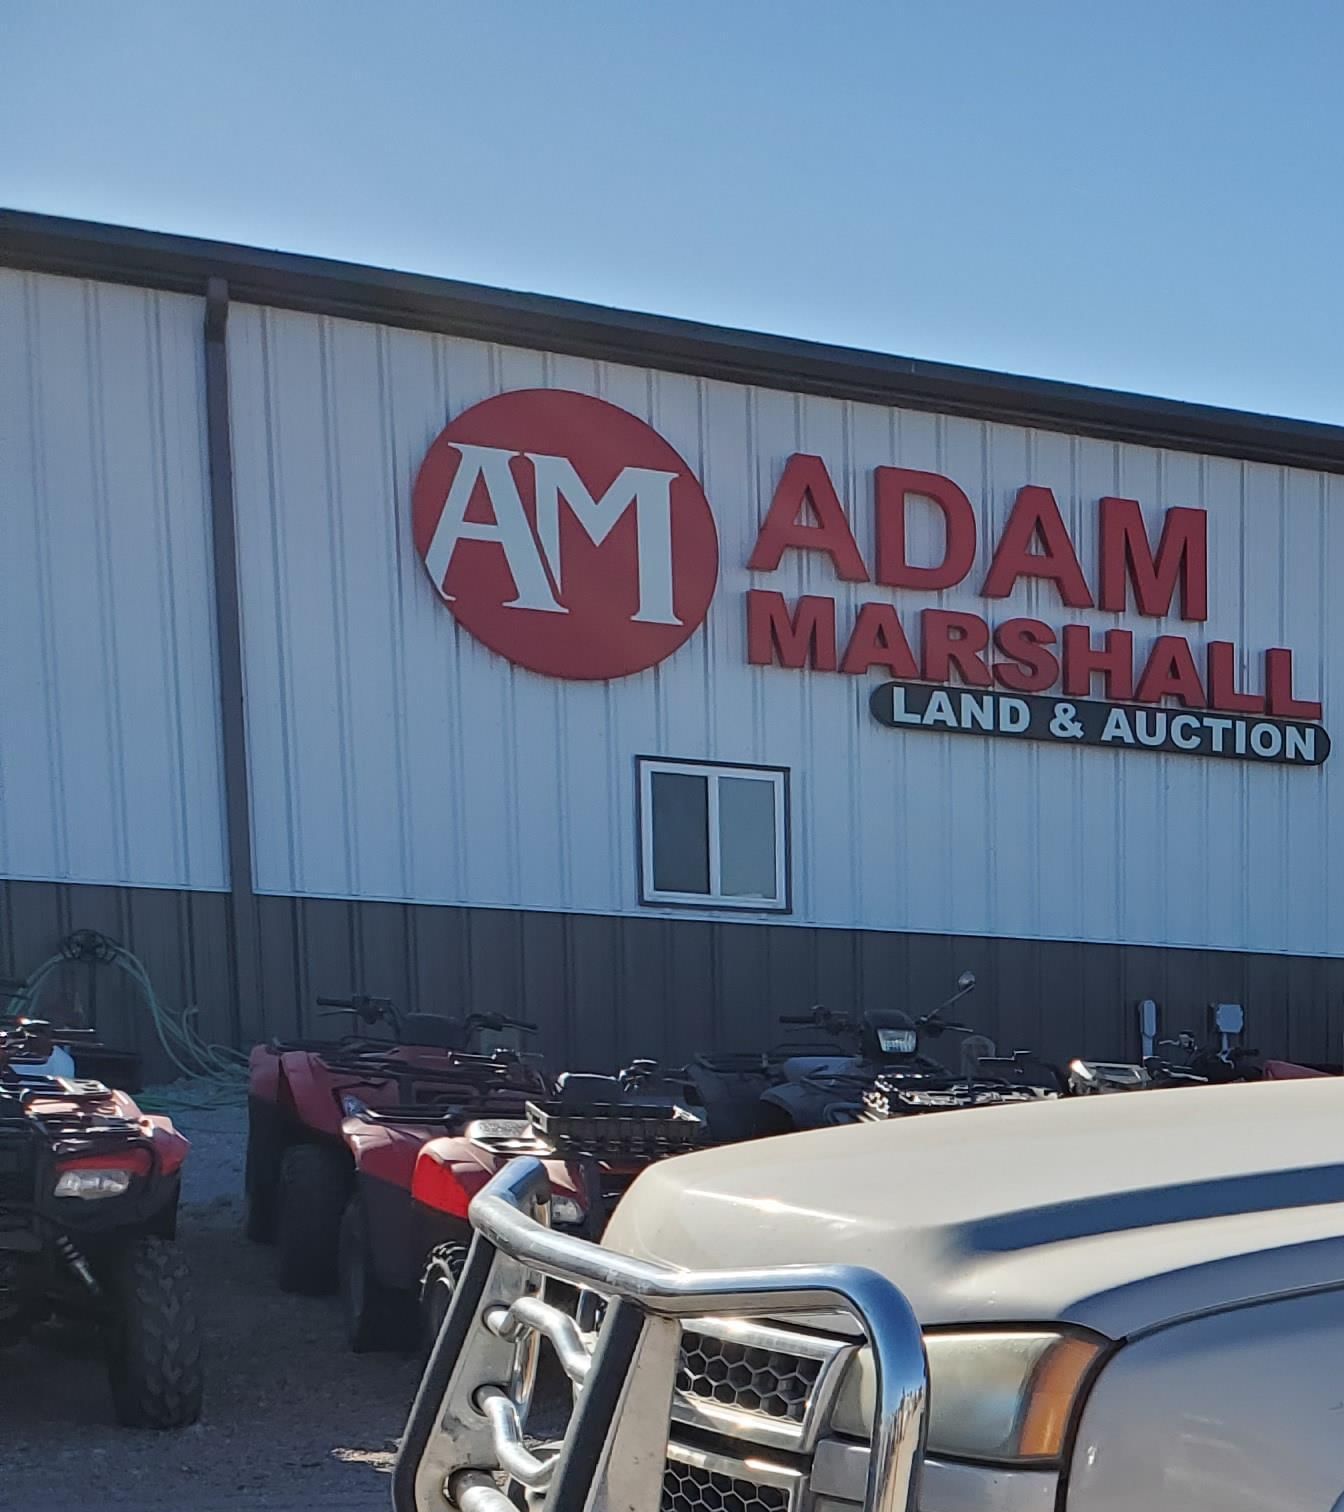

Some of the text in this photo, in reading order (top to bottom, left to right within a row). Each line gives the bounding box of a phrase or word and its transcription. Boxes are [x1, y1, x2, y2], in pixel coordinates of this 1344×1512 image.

[425, 442, 684, 627] AM
[748, 453, 1207, 620] ADAM
[746, 589, 1322, 720] MARSHALL
[892, 686, 1316, 761] LAND & AUCTION
